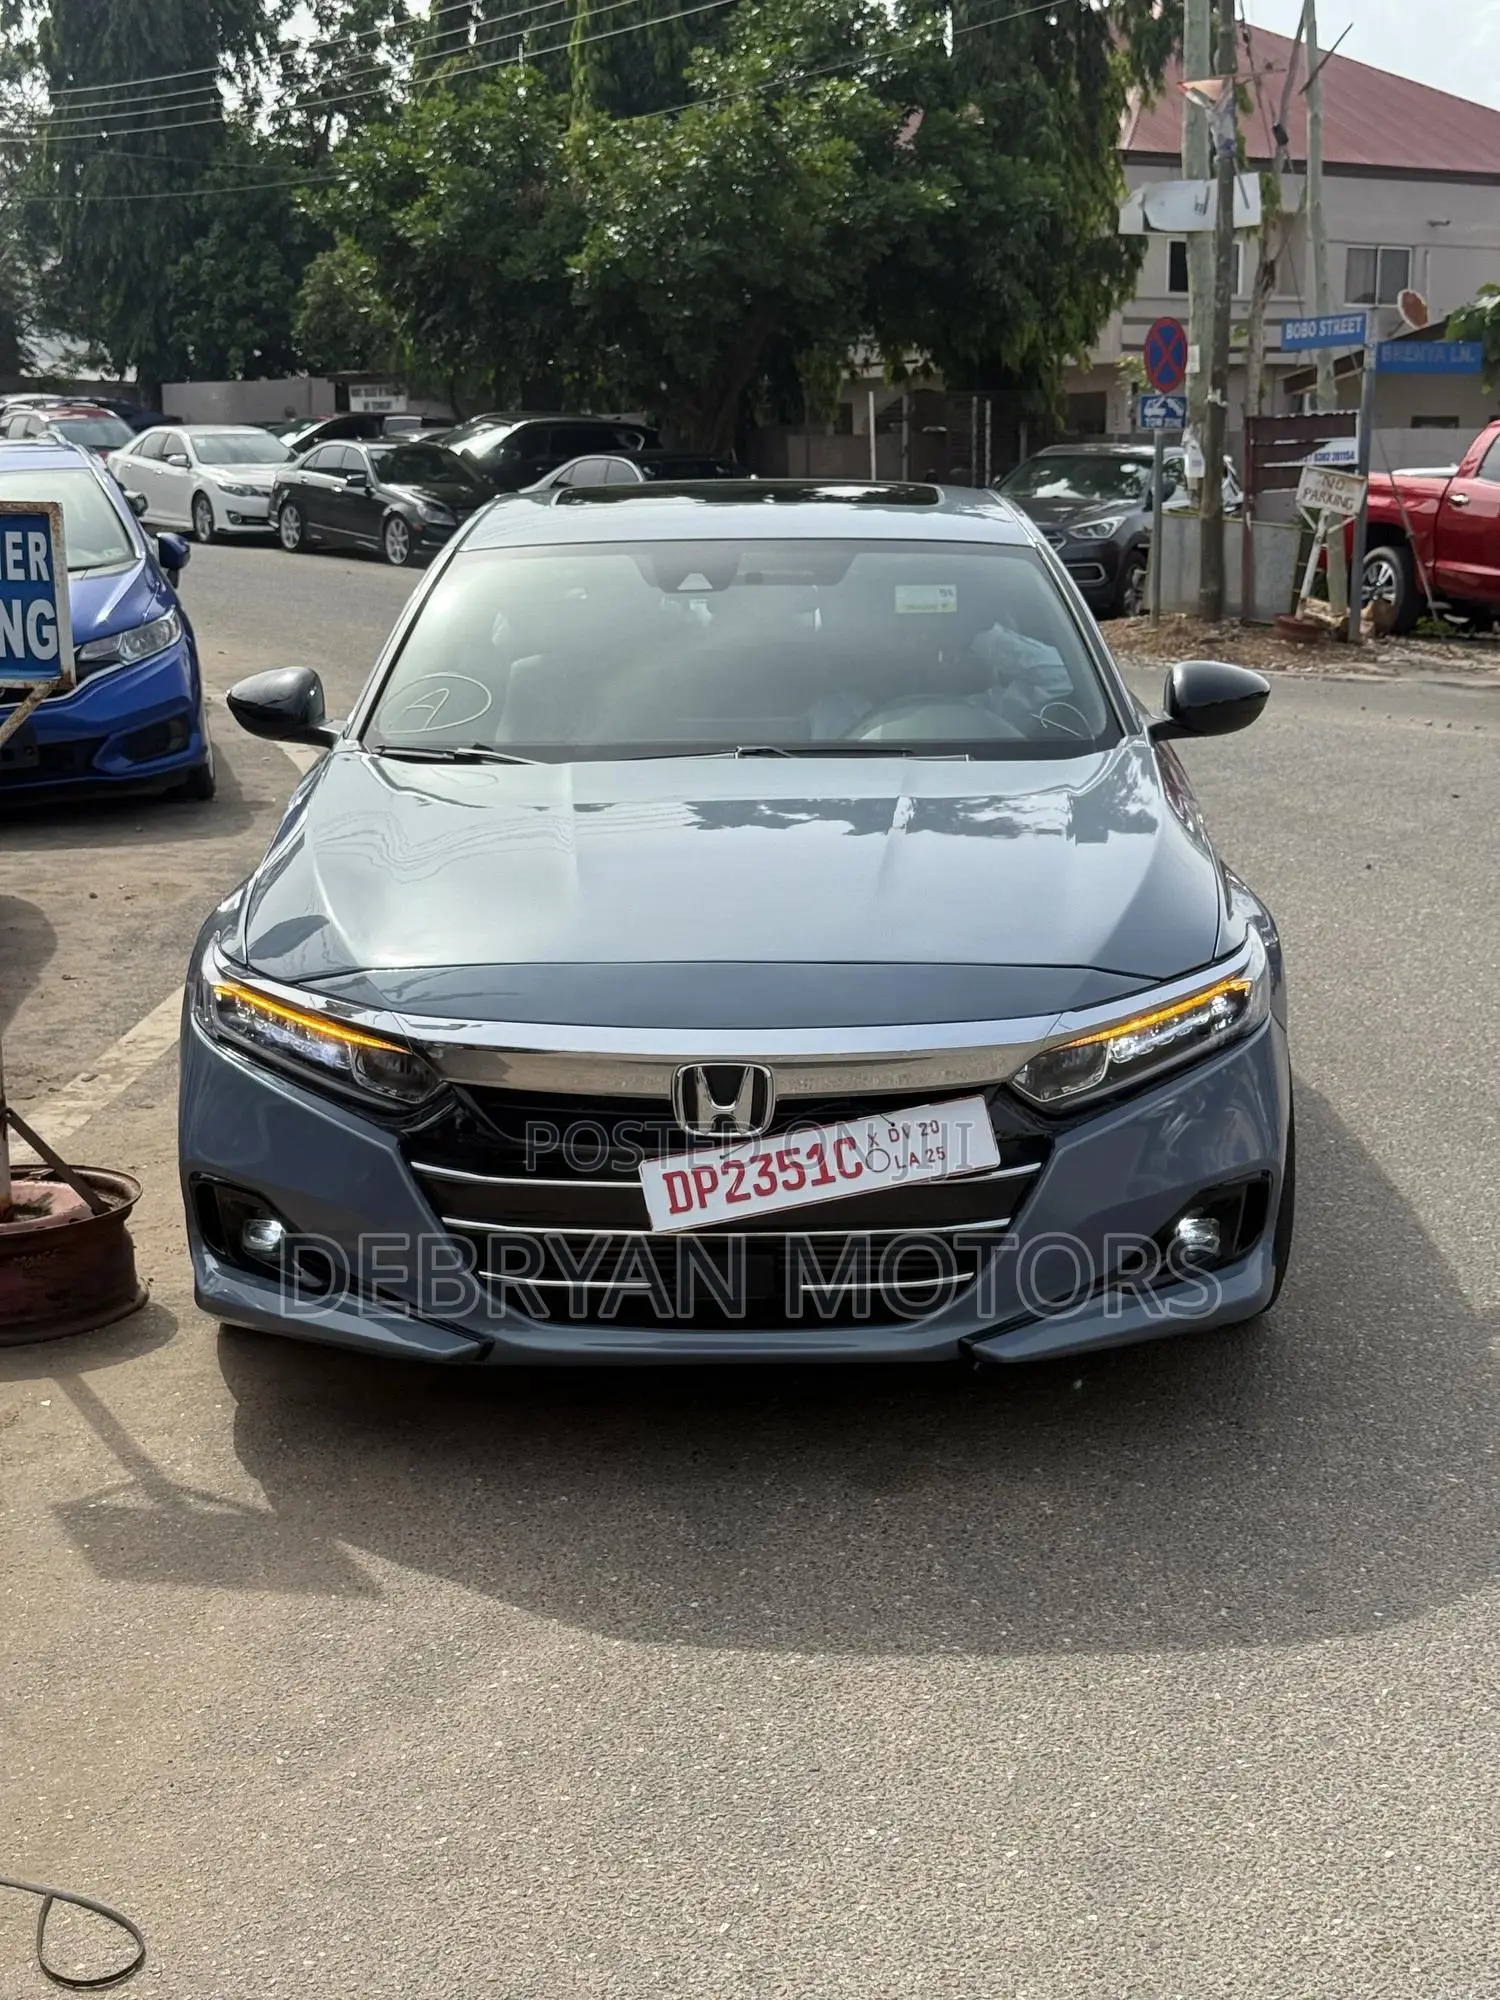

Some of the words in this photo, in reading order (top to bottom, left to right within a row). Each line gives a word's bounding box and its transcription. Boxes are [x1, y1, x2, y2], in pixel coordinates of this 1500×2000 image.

[1285, 321, 1315, 340] BOBO
[1318, 316, 1363, 337] STREET
[1320, 474, 1346, 491] NO
[1303, 486, 1355, 510] PARKING
[0, 531, 50, 581] ER
[918, 1119, 940, 1137] 20
[925, 1146, 947, 1163] 25
[662, 1136, 864, 1215] DP2351C
